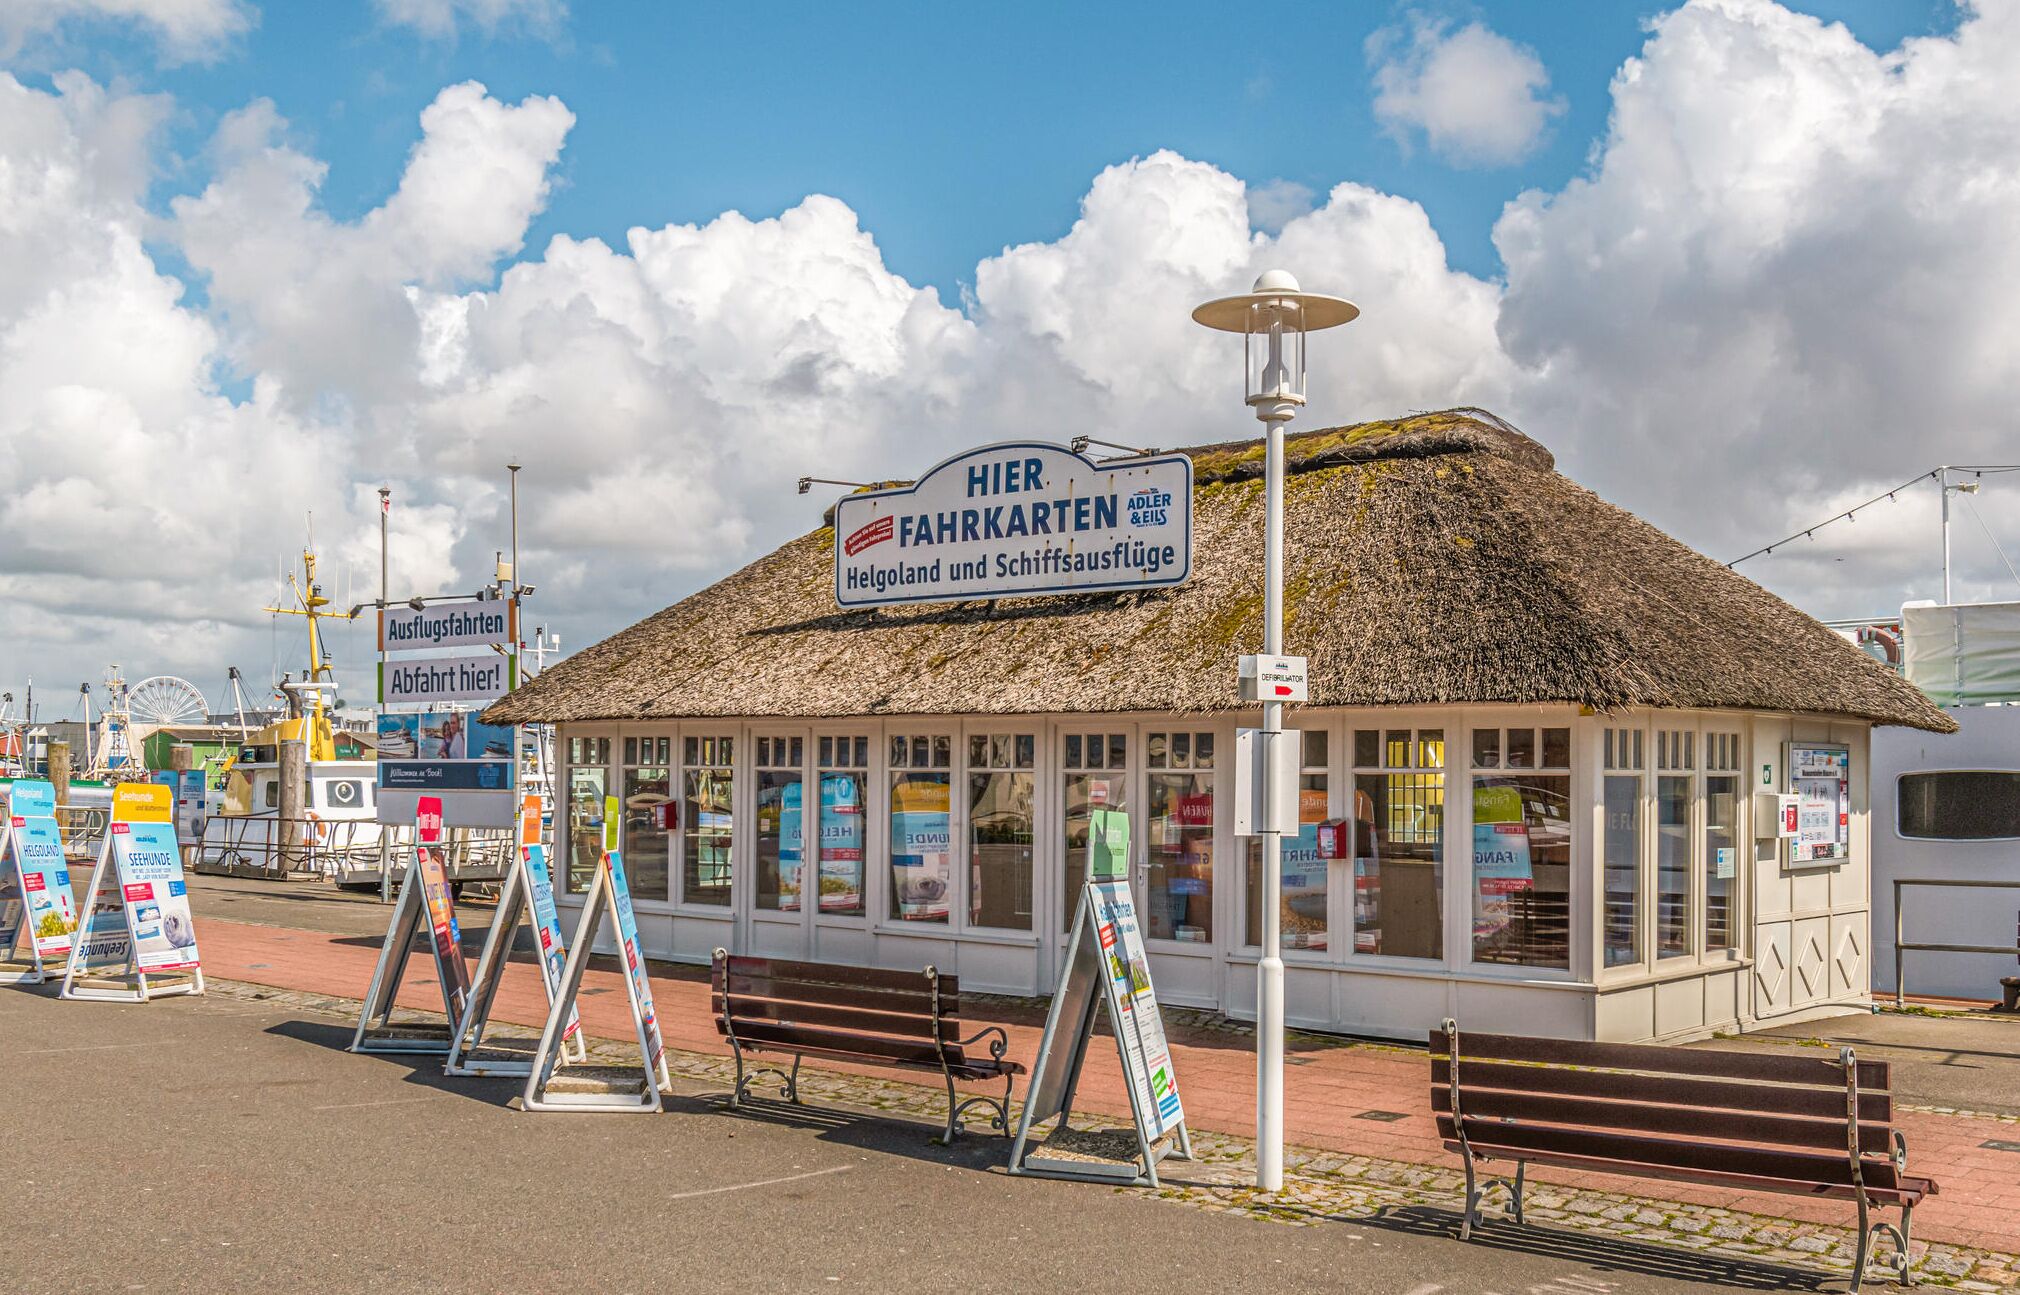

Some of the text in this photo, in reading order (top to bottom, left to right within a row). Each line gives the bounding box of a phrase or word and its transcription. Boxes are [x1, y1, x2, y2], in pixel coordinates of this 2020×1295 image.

[967, 458, 1043, 498] HIER
[1127, 493, 1171, 511] ADLER
[900, 494, 1118, 548] FAHRKARTEN
[847, 540, 1175, 593] Helgoland und Schiffsausflüge
[389, 611, 504, 642] Ausflugsfahrten
[391, 663, 500, 694] Abfahrt hier!
[1261, 673, 1304, 683] DEFIBRILLATOR
[119, 791, 154, 802] Seehunde
[24, 844, 59, 857] HELGOLAND
[129, 852, 171, 867] SEEHUNDE
[79, 941, 128, 960] Seehunde
